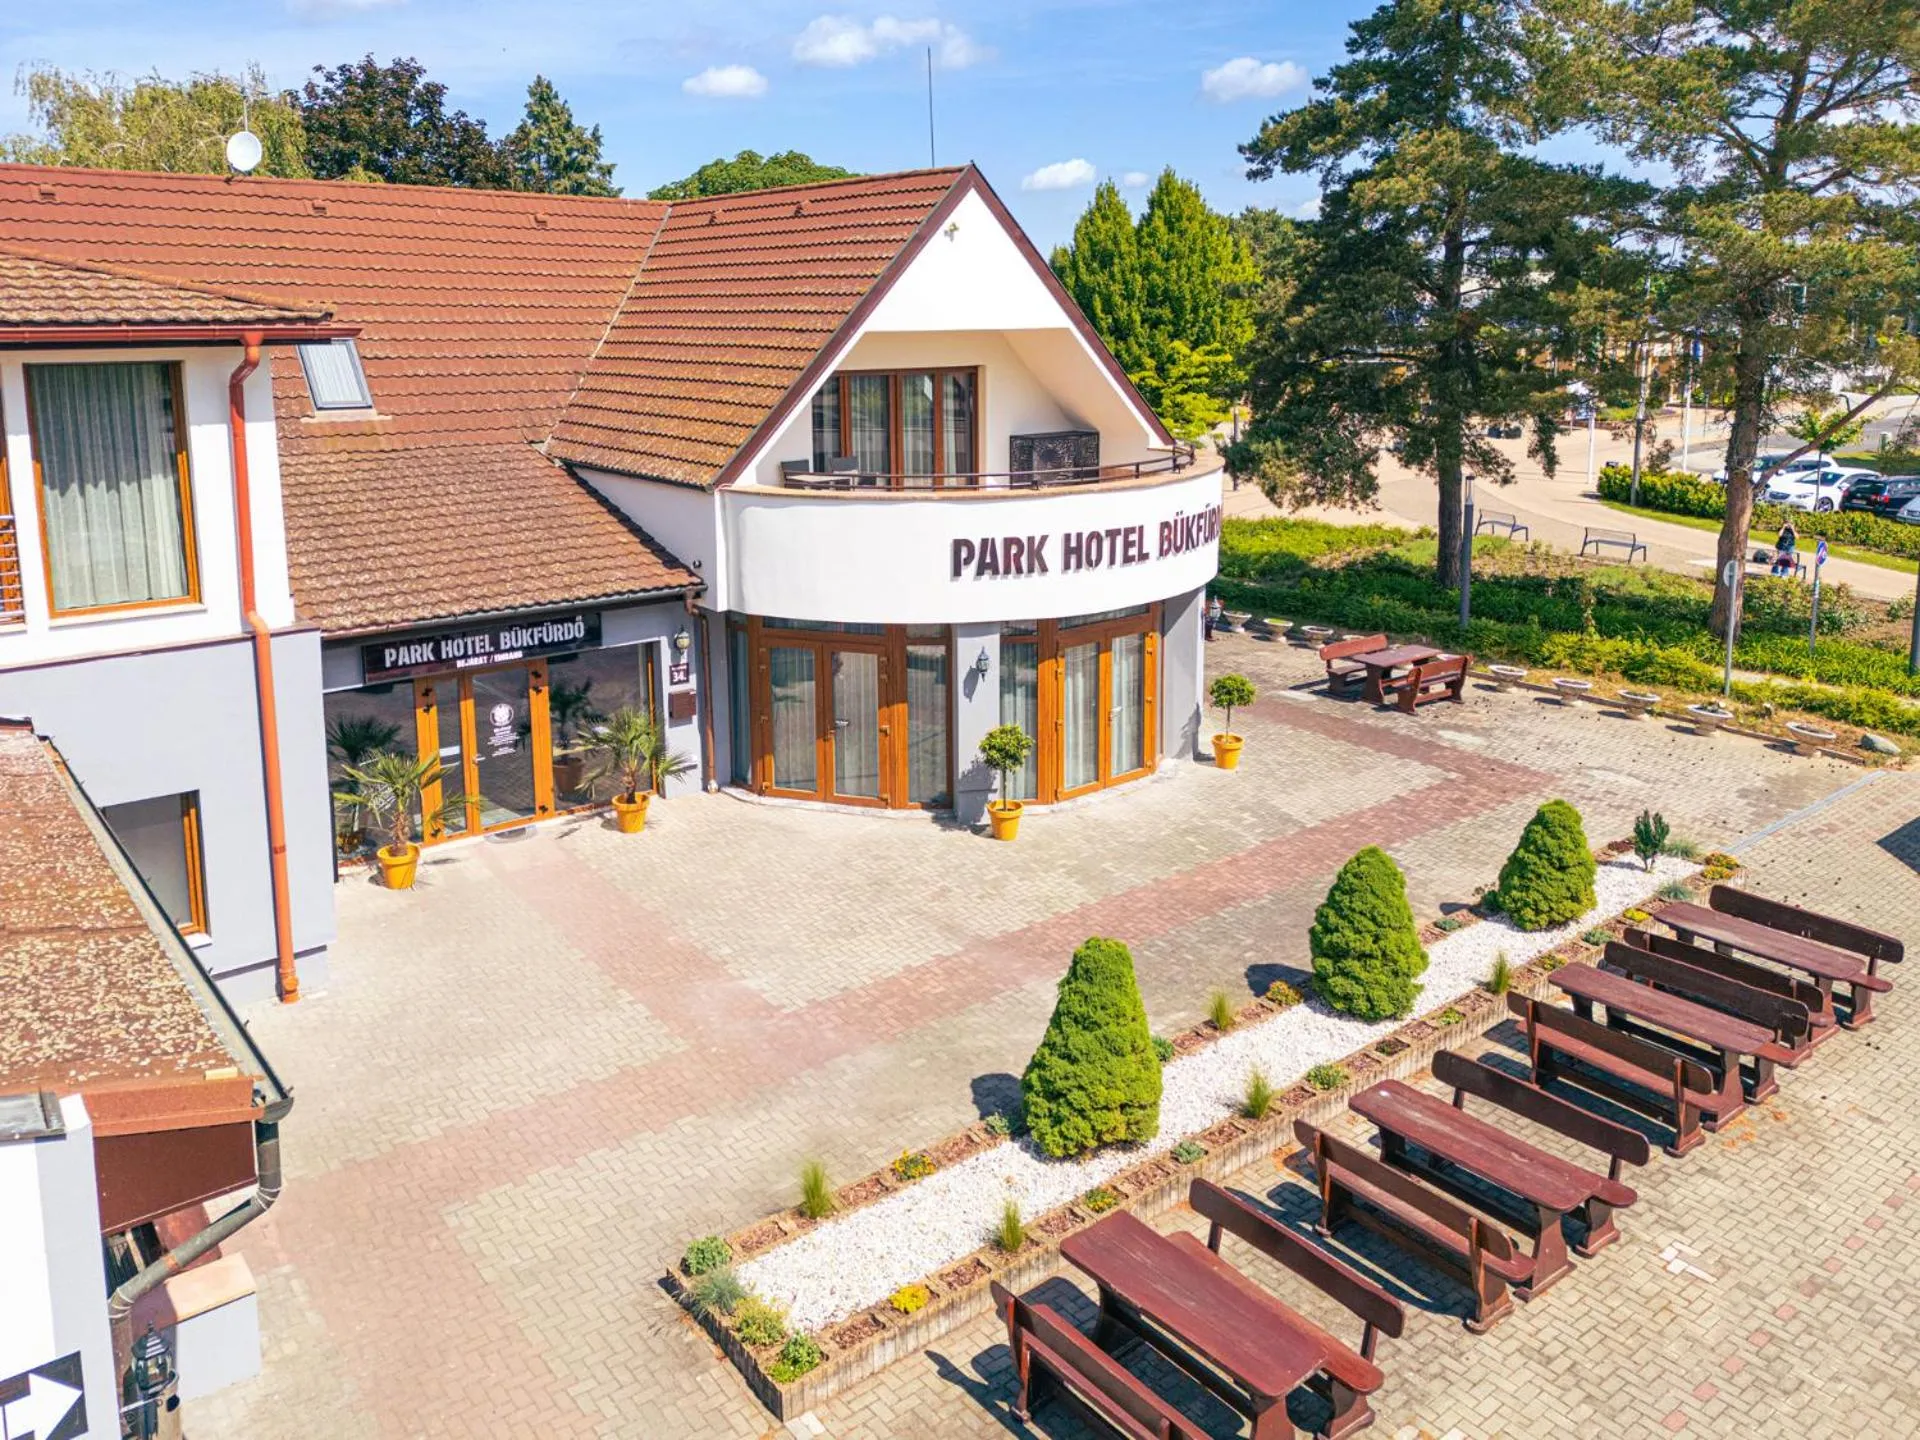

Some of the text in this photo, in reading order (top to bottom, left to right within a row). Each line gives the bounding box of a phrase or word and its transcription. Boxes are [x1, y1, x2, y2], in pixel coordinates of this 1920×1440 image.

[952, 534, 1049, 578] PARK
[1062, 525, 1150, 571] HOTEL
[385, 616, 585, 667] PARK HOTEL BÜKFÜRDŐ
